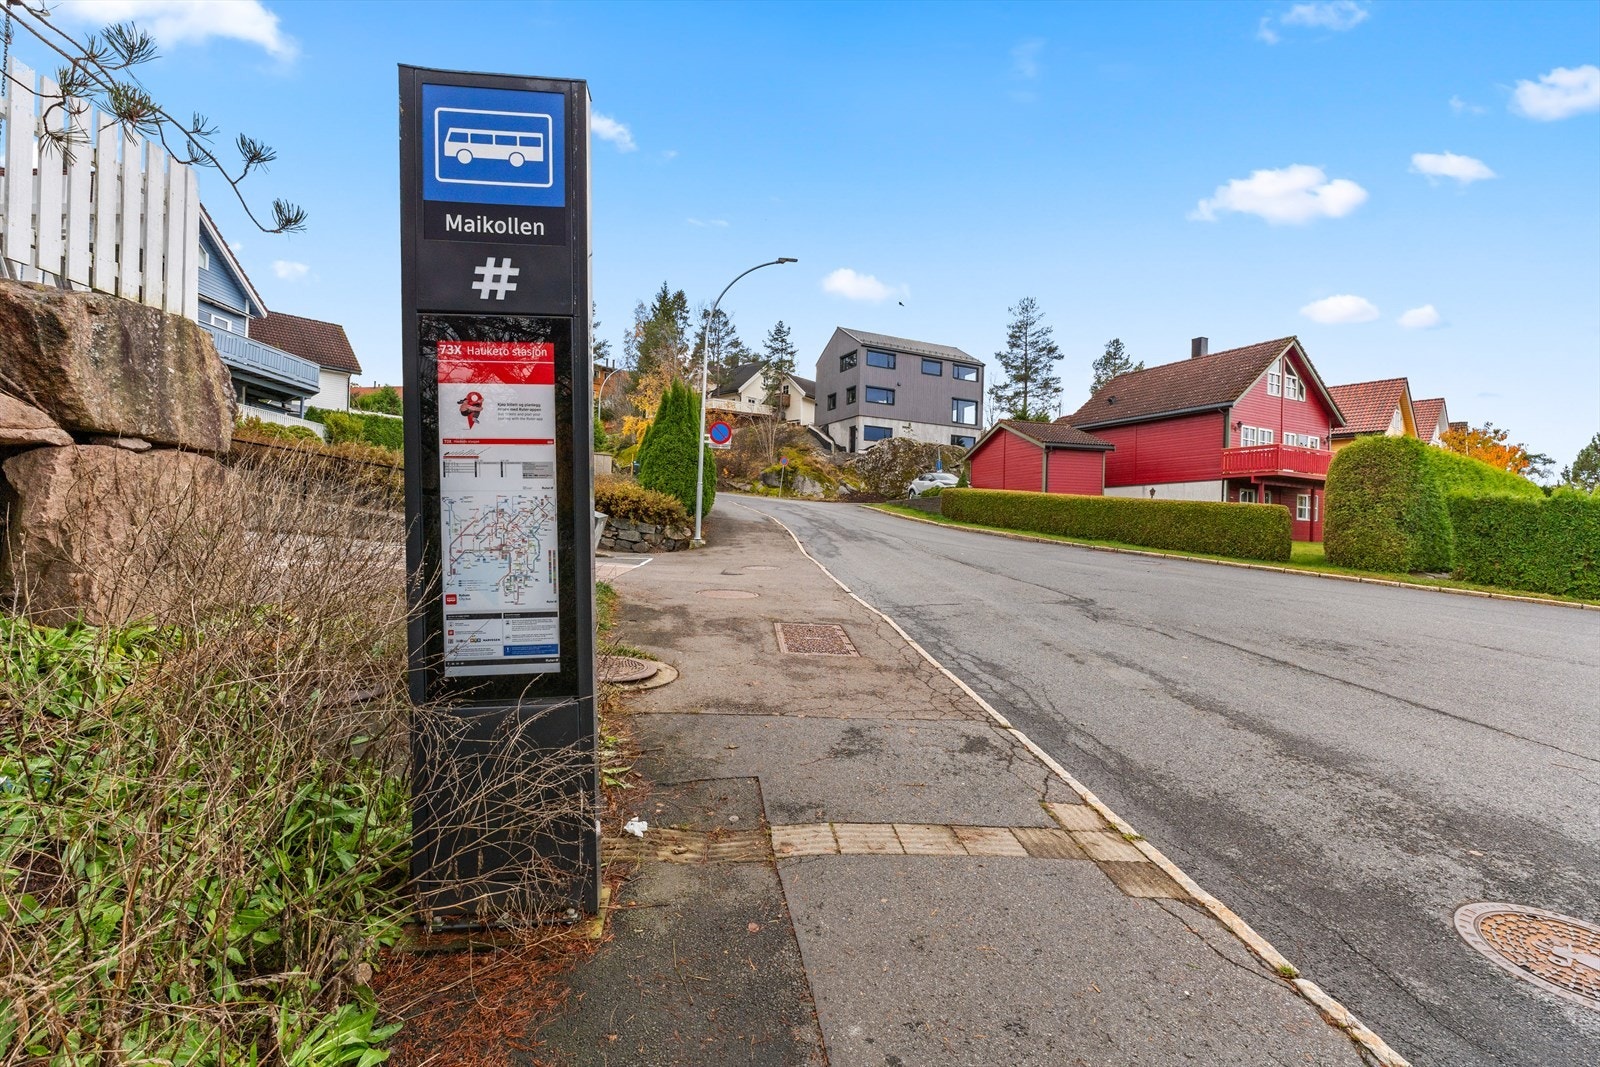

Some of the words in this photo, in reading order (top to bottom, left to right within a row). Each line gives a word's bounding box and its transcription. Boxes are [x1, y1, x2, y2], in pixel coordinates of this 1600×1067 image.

[445, 213, 545, 236] Maikollen
[439, 344, 462, 355] 73X
[466, 345, 510, 356] Hauketo
[511, 346, 548, 359] stasjon
